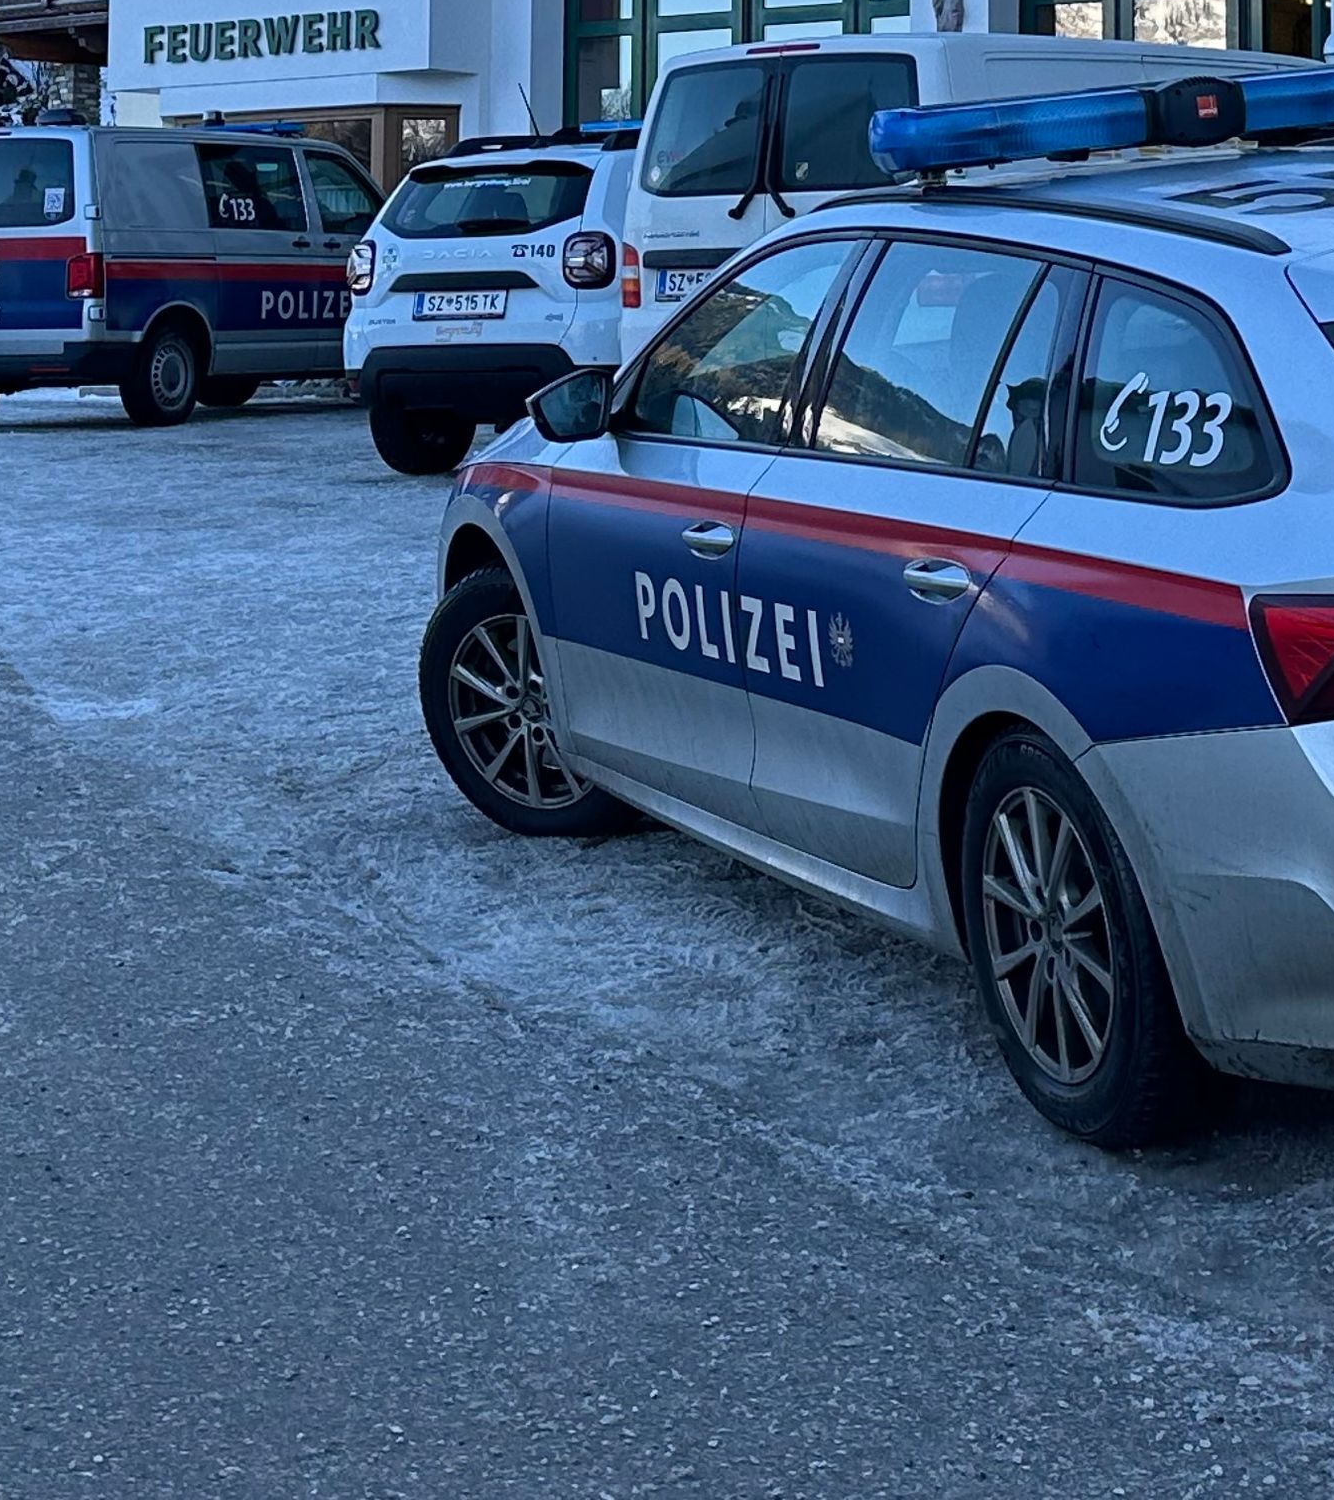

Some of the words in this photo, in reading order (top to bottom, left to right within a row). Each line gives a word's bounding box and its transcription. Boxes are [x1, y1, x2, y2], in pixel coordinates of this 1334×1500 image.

[144, 9, 381, 64] FEUERWEHR
[230, 198, 255, 221] 133
[422, 249, 492, 261] DACIA
[530, 244, 556, 258] 140
[669, 273, 685, 291] SZ
[261, 290, 350, 320] POLIZE
[428, 296, 447, 312] SZ
[454, 295, 478, 311] 515
[482, 294, 500, 310] TK
[1143, 390, 1233, 467] 133
[635, 571, 824, 687] POLIZEI
